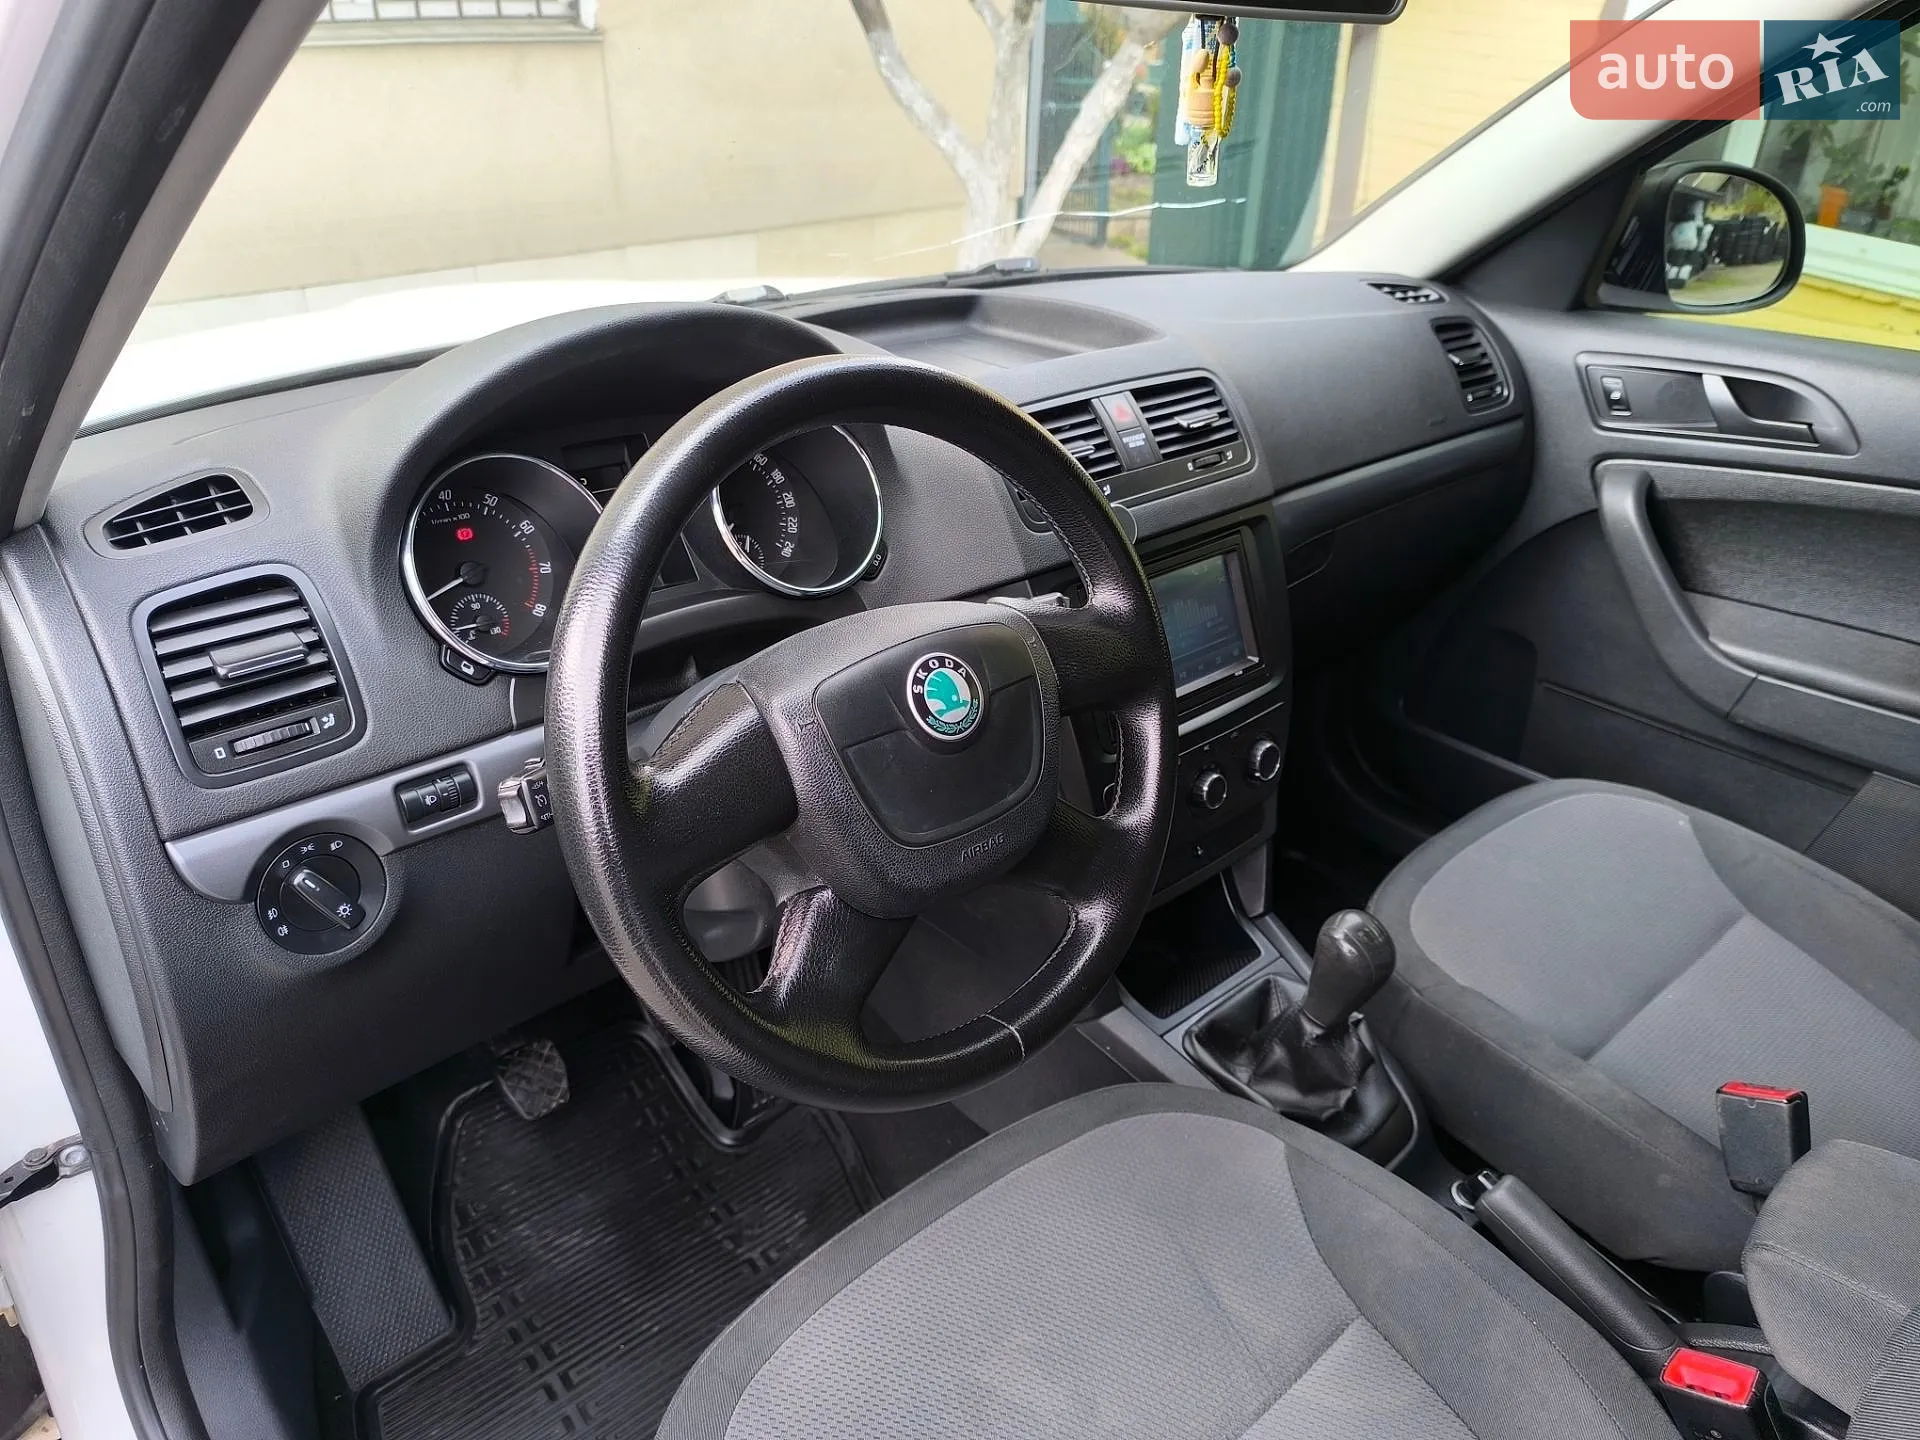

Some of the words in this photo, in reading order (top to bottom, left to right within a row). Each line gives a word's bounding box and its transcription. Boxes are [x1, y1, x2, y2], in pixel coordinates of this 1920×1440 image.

[770, 468, 785, 484] 180
[438, 489, 452, 501] 40
[483, 493, 499, 508] 50
[782, 491, 796, 509] 200
[519, 519, 535, 535] 60
[787, 516, 798, 534] 220
[781, 541, 795, 558] 240
[539, 561, 552, 575] 70
[470, 602, 481, 611] 90
[533, 604, 547, 617] 80
[961, 832, 1005, 863] AIRBAG
